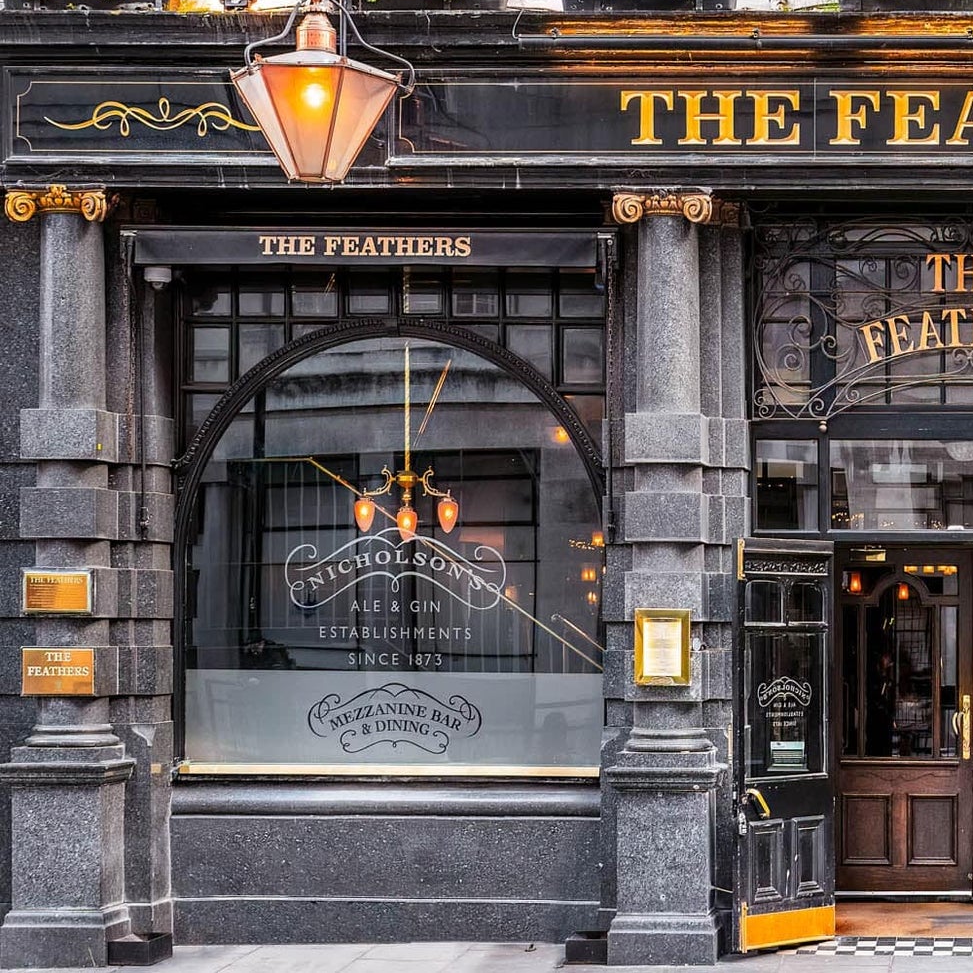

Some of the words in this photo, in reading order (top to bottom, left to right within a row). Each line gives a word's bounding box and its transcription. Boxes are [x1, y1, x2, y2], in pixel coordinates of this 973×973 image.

[620, 90, 800, 146] THE
[259, 236, 315, 255] THE
[323, 236, 471, 257] FEATHERS
[307, 550, 485, 591] NICHOLSON'S
[350, 600, 381, 612] ALE
[391, 601, 400, 612] &
[410, 601, 441, 613] GIN
[319, 626, 472, 640] ESTABLISHMENTS
[45, 652, 72, 662] THE
[348, 653, 399, 665] SINCE
[408, 654, 443, 666] 1873
[27, 666, 89, 676] FEATHERS
[329, 702, 427, 731] MEZZANINE
[430, 709, 462, 731] BAR
[362, 723, 373, 735] &
[375, 719, 430, 736] DINING
